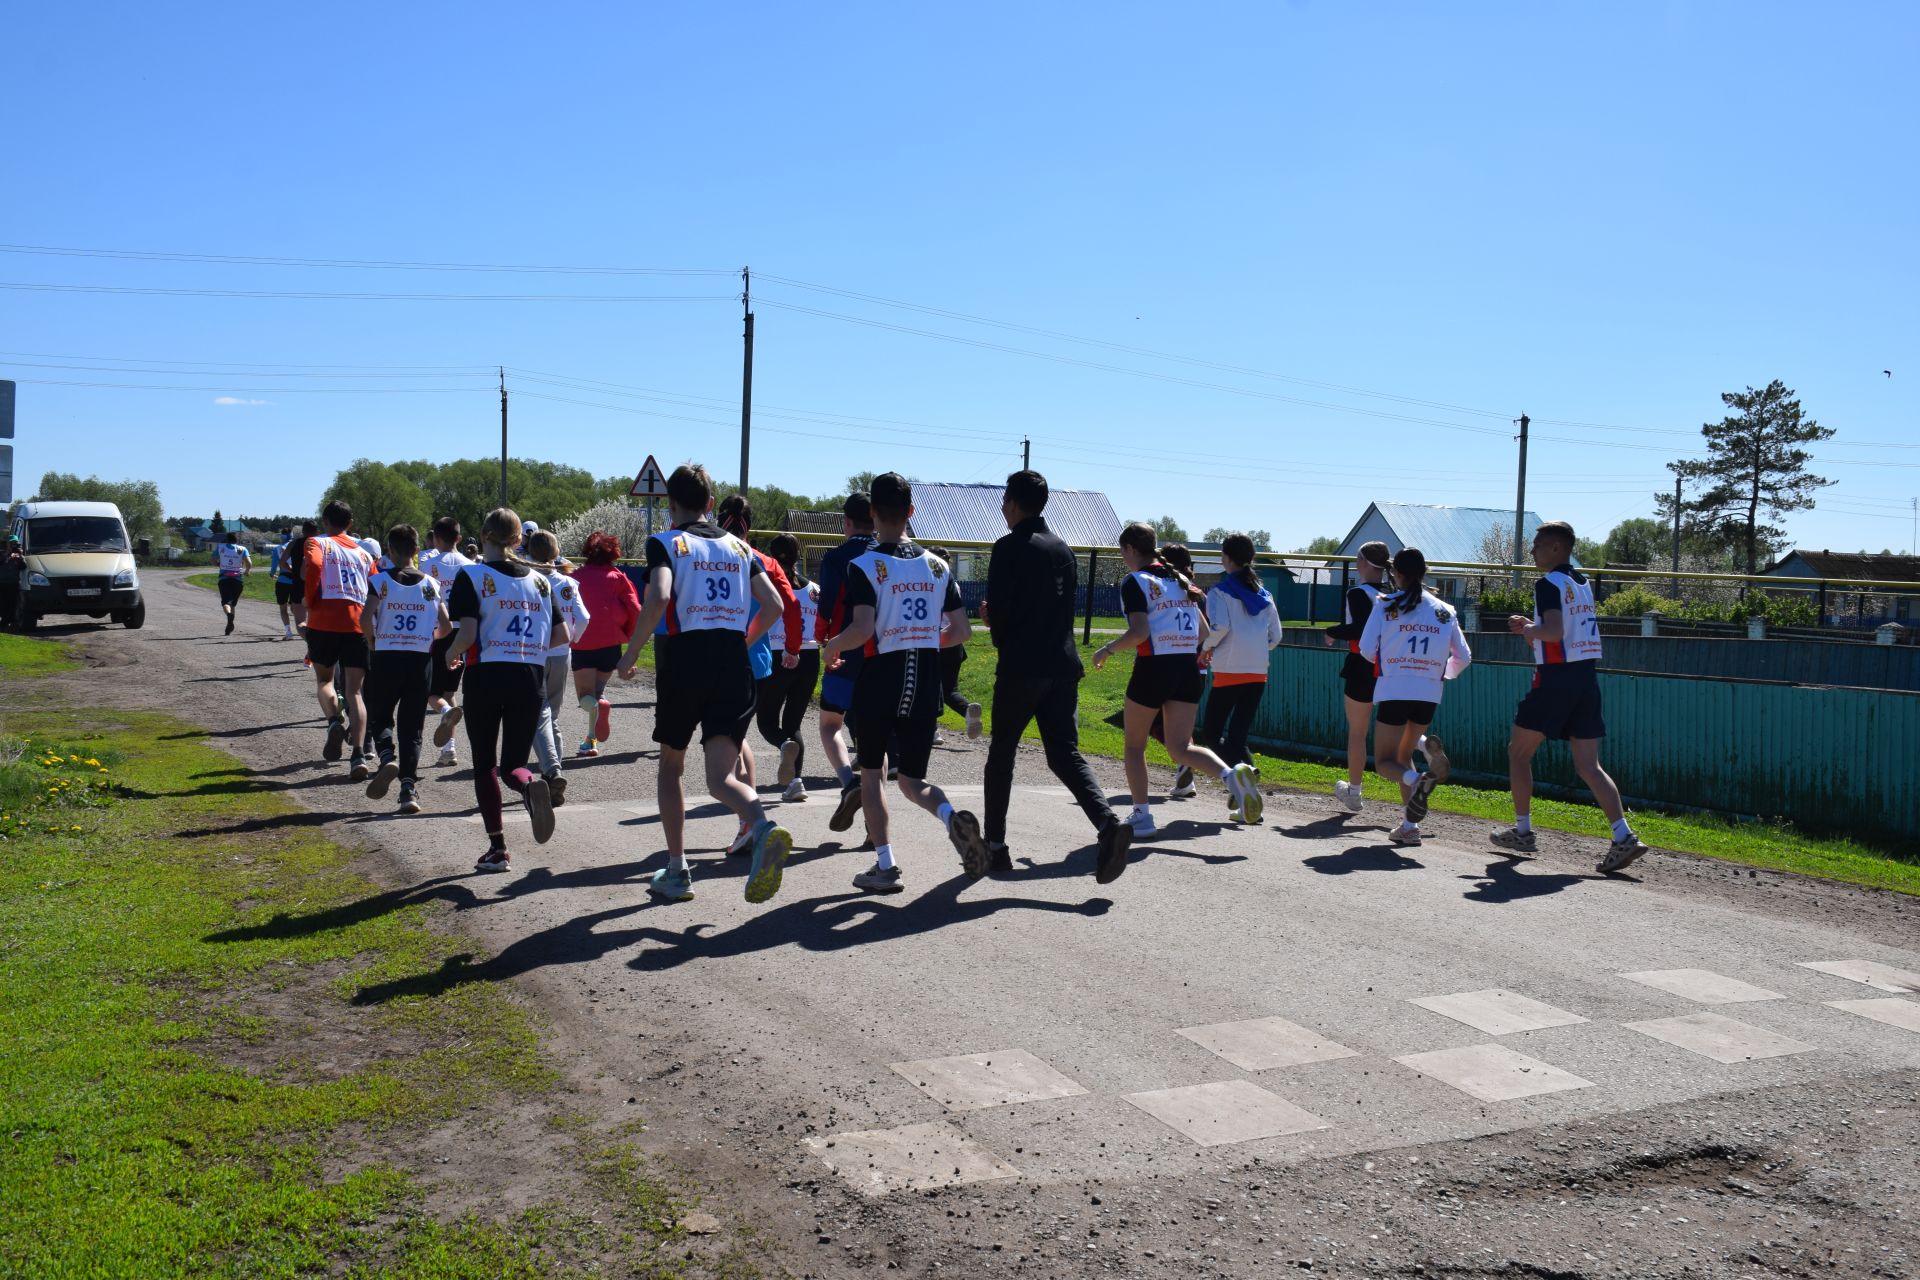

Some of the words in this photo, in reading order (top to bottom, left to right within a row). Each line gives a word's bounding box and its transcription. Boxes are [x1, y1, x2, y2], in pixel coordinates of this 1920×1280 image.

[693, 561, 740, 573] РОССИЯ
[705, 577, 731, 601] 39
[387, 602, 425, 612] РОССИЯ
[500, 600, 541, 613] РОССИЯ
[902, 597, 928, 621] 38
[393, 614, 417, 632] 36
[506, 614, 534, 638] 42
[1174, 612, 1193, 632] 12
[1399, 623, 1441, 635] РОССИЯ
[1407, 635, 1430, 656] 11
